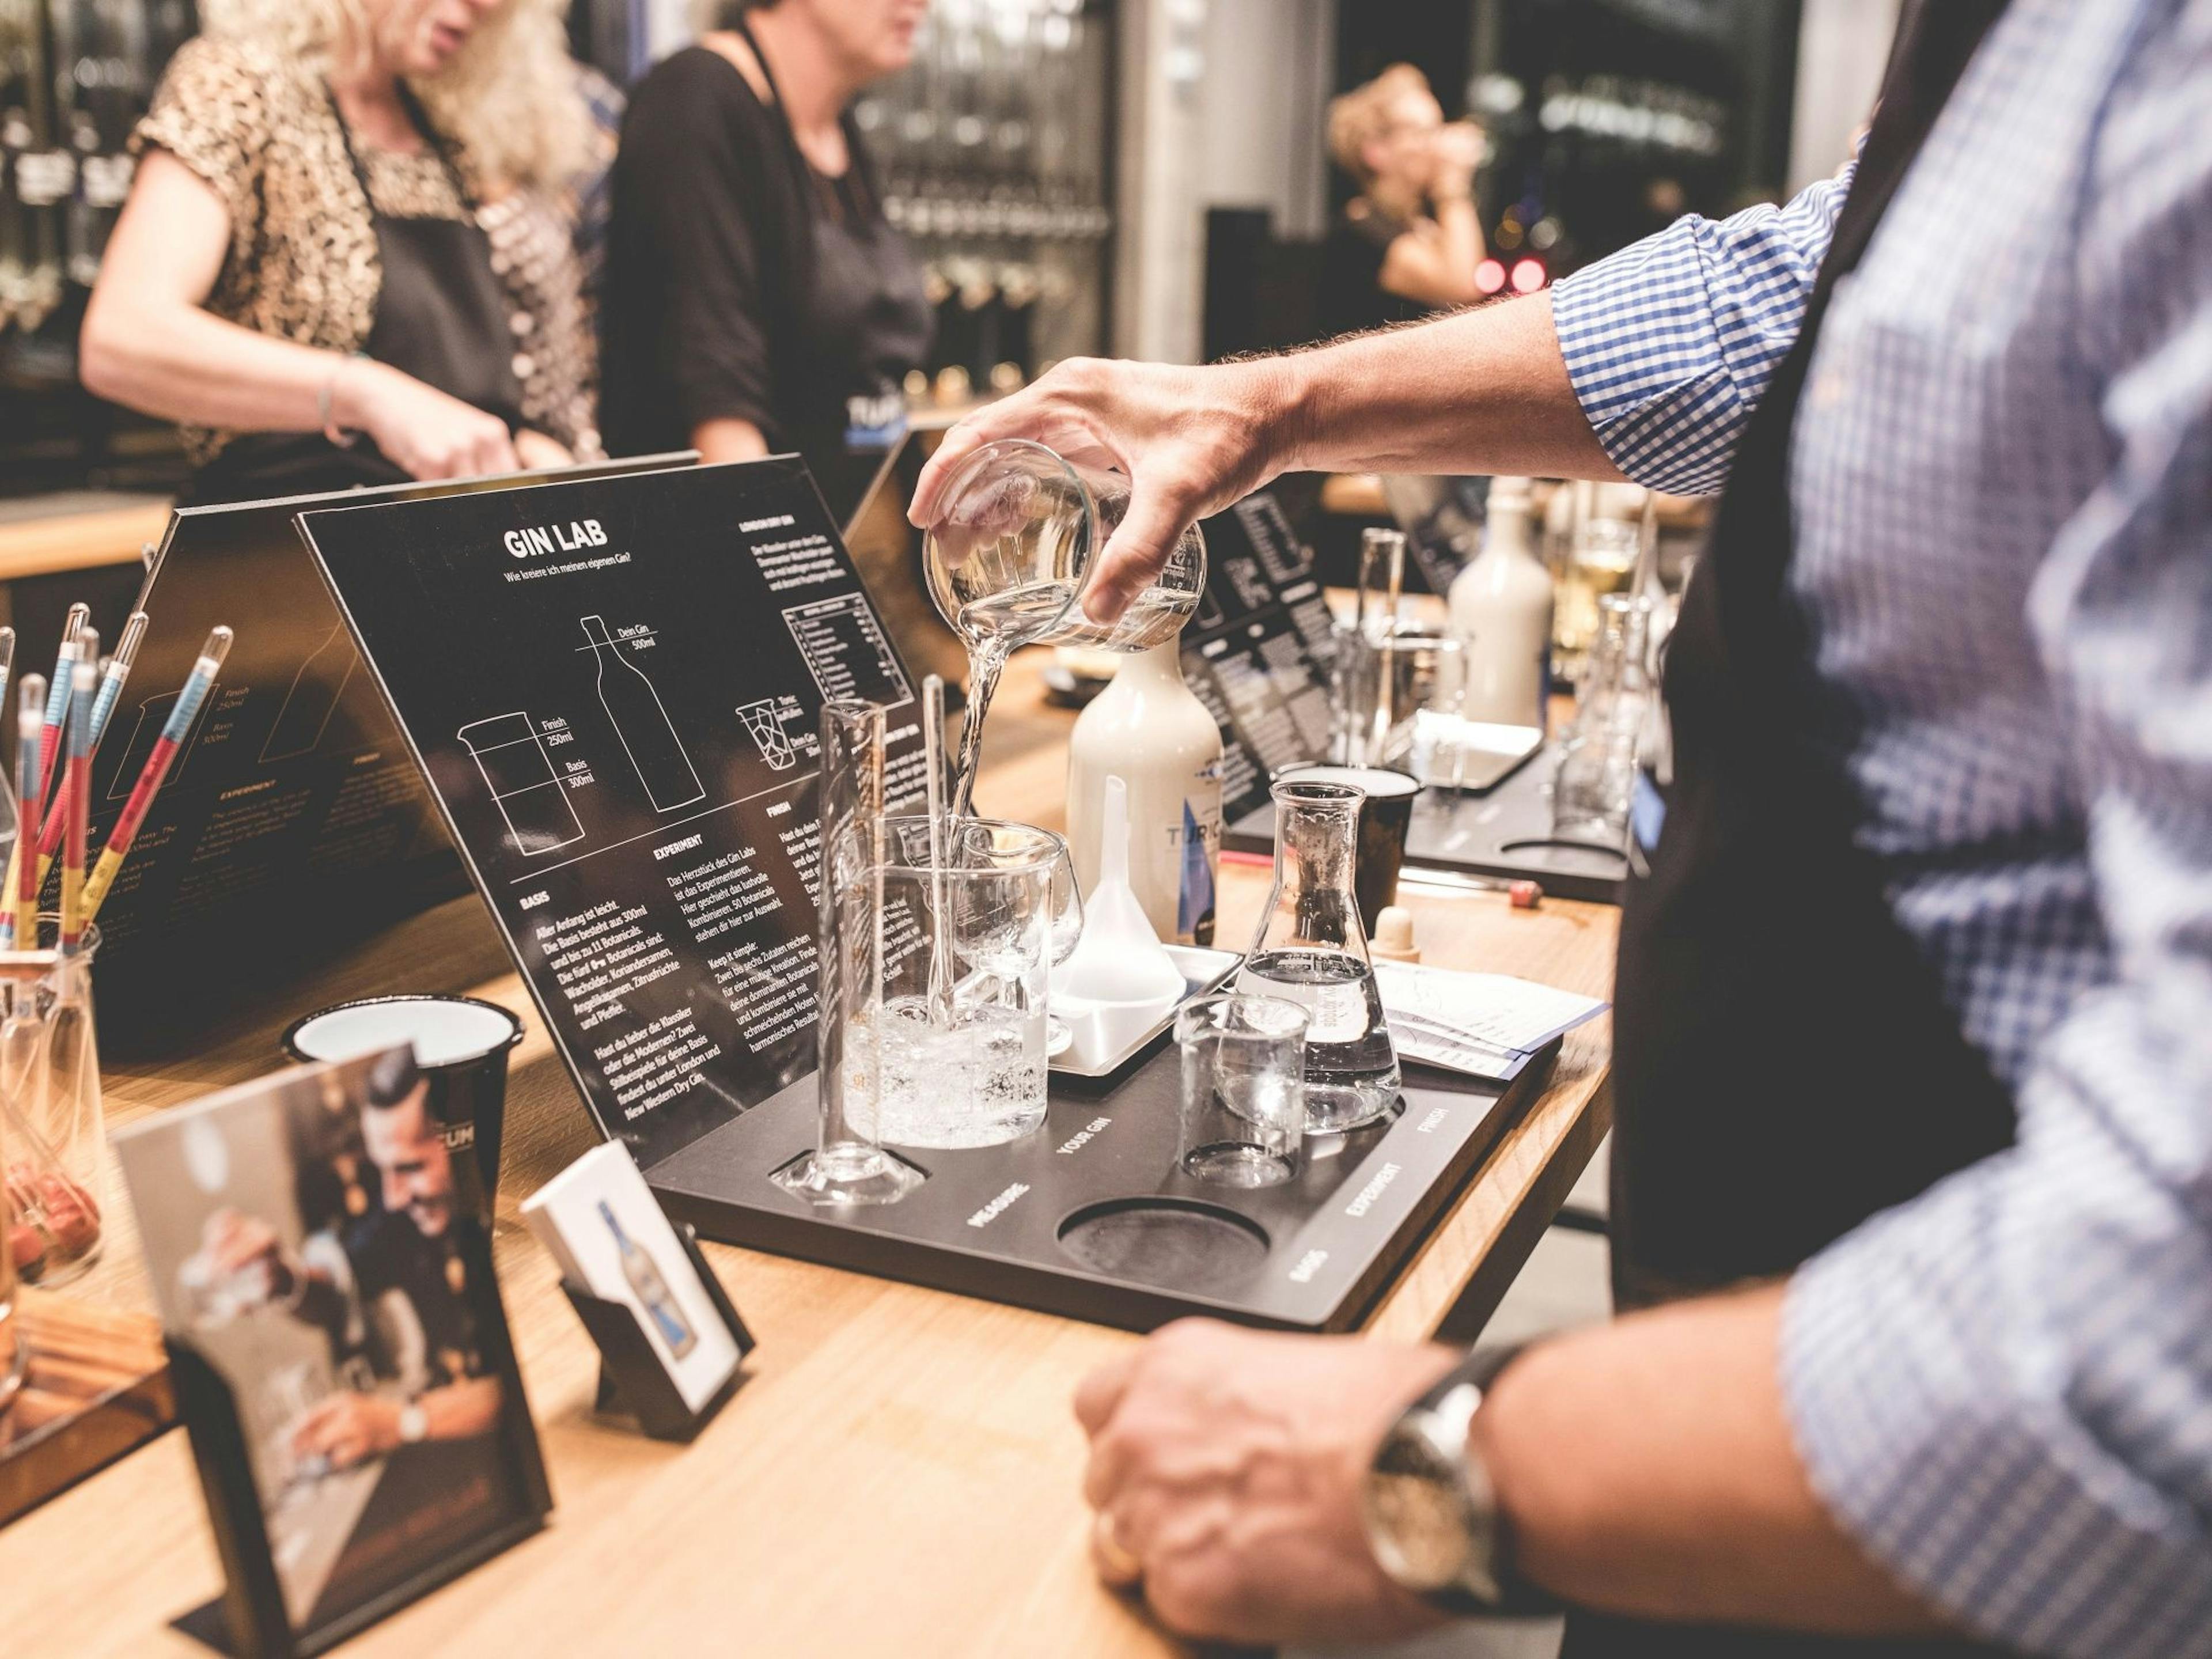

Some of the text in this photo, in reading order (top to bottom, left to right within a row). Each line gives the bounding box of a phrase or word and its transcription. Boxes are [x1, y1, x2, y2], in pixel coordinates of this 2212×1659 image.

[504, 519, 608, 558] GIN LAB
[504, 552, 631, 582] Wie kreiere ich meinen eigenen Gin?
[618, 624, 649, 638] Dein Gin
[632, 637, 656, 650] 500ml
[541, 717, 567, 730] Finish
[547, 731, 574, 746] 250ml
[566, 759, 587, 772] Basis
[568, 772, 594, 788] 300ml
[766, 801, 791, 818] FINISH
[653, 834, 703, 860] EXPERIMENT
[666, 847, 756, 888] Das Herzstück des Gin Labs
[520, 891, 550, 910] BASIS
[674, 865, 752, 901] ist das Experimentieren.
[681, 873, 769, 915] Hier geschieht das lustvolle
[536, 900, 620, 940] Aller Anfang ist leicht.
[687, 886, 775, 929] Kombinieren. 50 Botanicals
[695, 897, 783, 942] stehen dir hier zur Auswahl.
[541, 904, 647, 955] Die Basis besteht aus 300ml
[550, 925, 643, 970] und bis zu 11 Botanicals.
[556, 933, 664, 985] Die fünf Botanicals sind:
[564, 948, 673, 999] Wacholder, Koriandersamen,
[708, 942, 758, 970] Keep it simple:
[715, 934, 811, 984] Zwei bis sechs Zutaten reichen
[722, 946, 818, 997] für eine mutige Kreation. Finde
[730, 961, 819, 1012] deine dominanten Botanicals
[736, 983, 809, 1025] und kombiniere sie mit
[580, 1004, 626, 1031] und Pfeffer.
[594, 1007, 692, 1060] Hast du lieber die Klassiker
[744, 996, 817, 1039] schmeichelnden Noten
[749, 1023, 796, 1053] harmonisches
[604, 1021, 696, 1075] oder die Modernen? Zwei
[609, 1035, 708, 1090] Stilbeispiele für deine Basis
[617, 1044, 721, 1105] findest du unter London und
[624, 1073, 706, 1120] New Western Dry Gin.
[1056, 1117, 1112, 1154] YOUR GIN
[1417, 1107, 1450, 1133] FINISH
[967, 1183, 1030, 1228] MEASURE
[1345, 1162, 1403, 1217] EXPERIMENT
[1289, 1249, 1328, 1283] BASIS
